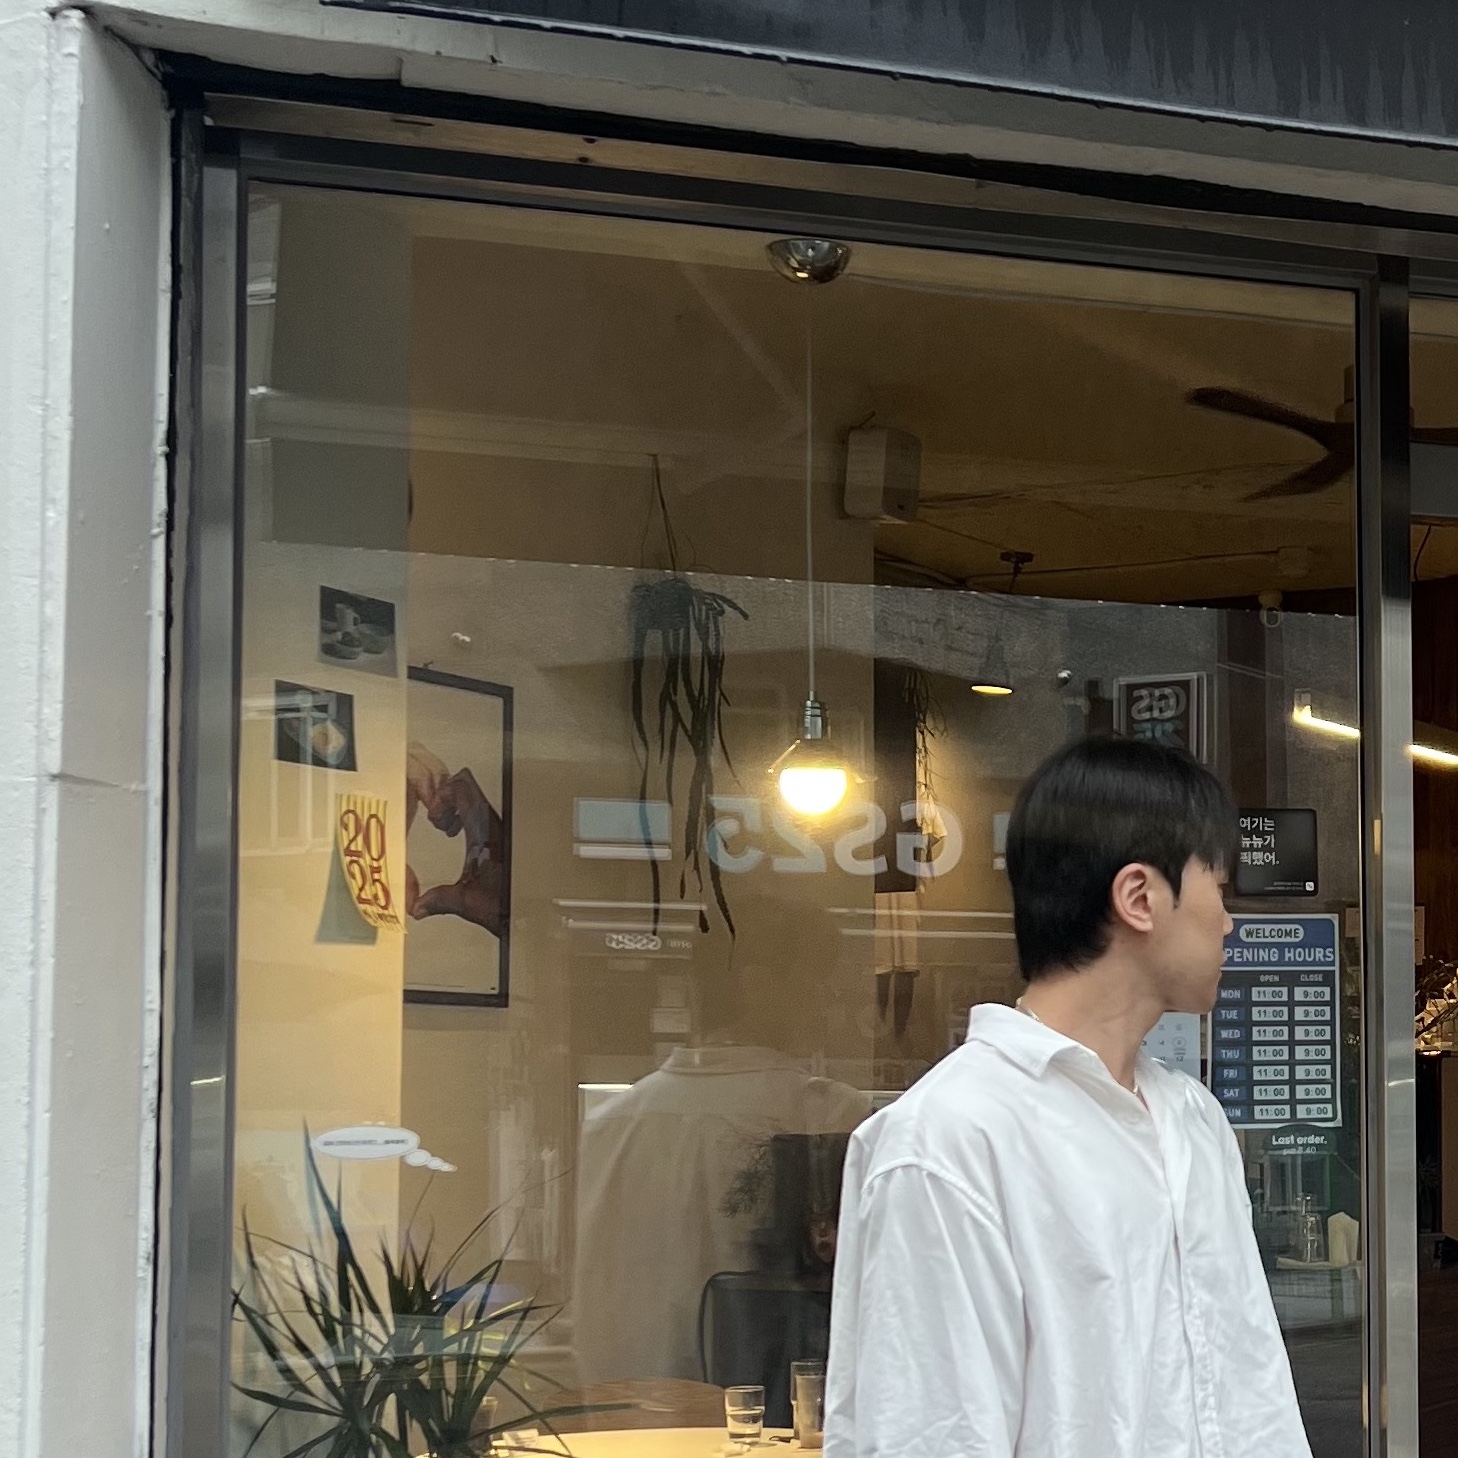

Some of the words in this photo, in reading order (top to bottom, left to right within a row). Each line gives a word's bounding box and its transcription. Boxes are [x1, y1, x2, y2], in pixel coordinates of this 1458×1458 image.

[1239, 816, 1276, 831] 여기는
[340, 809, 386, 861] 20
[346, 858, 391, 910] 25
[1244, 927, 1301, 939] WELCOME
[1222, 947, 1279, 962] PENING
[1284, 947, 1334, 962] HOURS
[1259, 974, 1280, 982] OPEN
[1300, 973, 1323, 982] CLOSE
[1256, 989, 1284, 1000] 11:00
[1302, 990, 1326, 1000] 9:00
[1257, 1009, 1285, 1019] 11:00
[1303, 1009, 1327, 1019] 9:00
[1257, 1028, 1285, 1038] 11:00
[1303, 1028, 1327, 1038] 9:00
[1257, 1048, 1285, 1058] 11:00
[1304, 1048, 1327, 1057] 9:00
[1257, 1068, 1286, 1078] 11:00
[1304, 1068, 1327, 1077] 9:00
[1258, 1088, 1286, 1097] 11:00
[1304, 1087, 1327, 1097] 9:00
[1259, 1107, 1287, 1117] 11:00
[1305, 1106, 1329, 1116] 9:00
[1271, 1134, 1295, 1145] Last
[1296, 1134, 1328, 1145] order.
